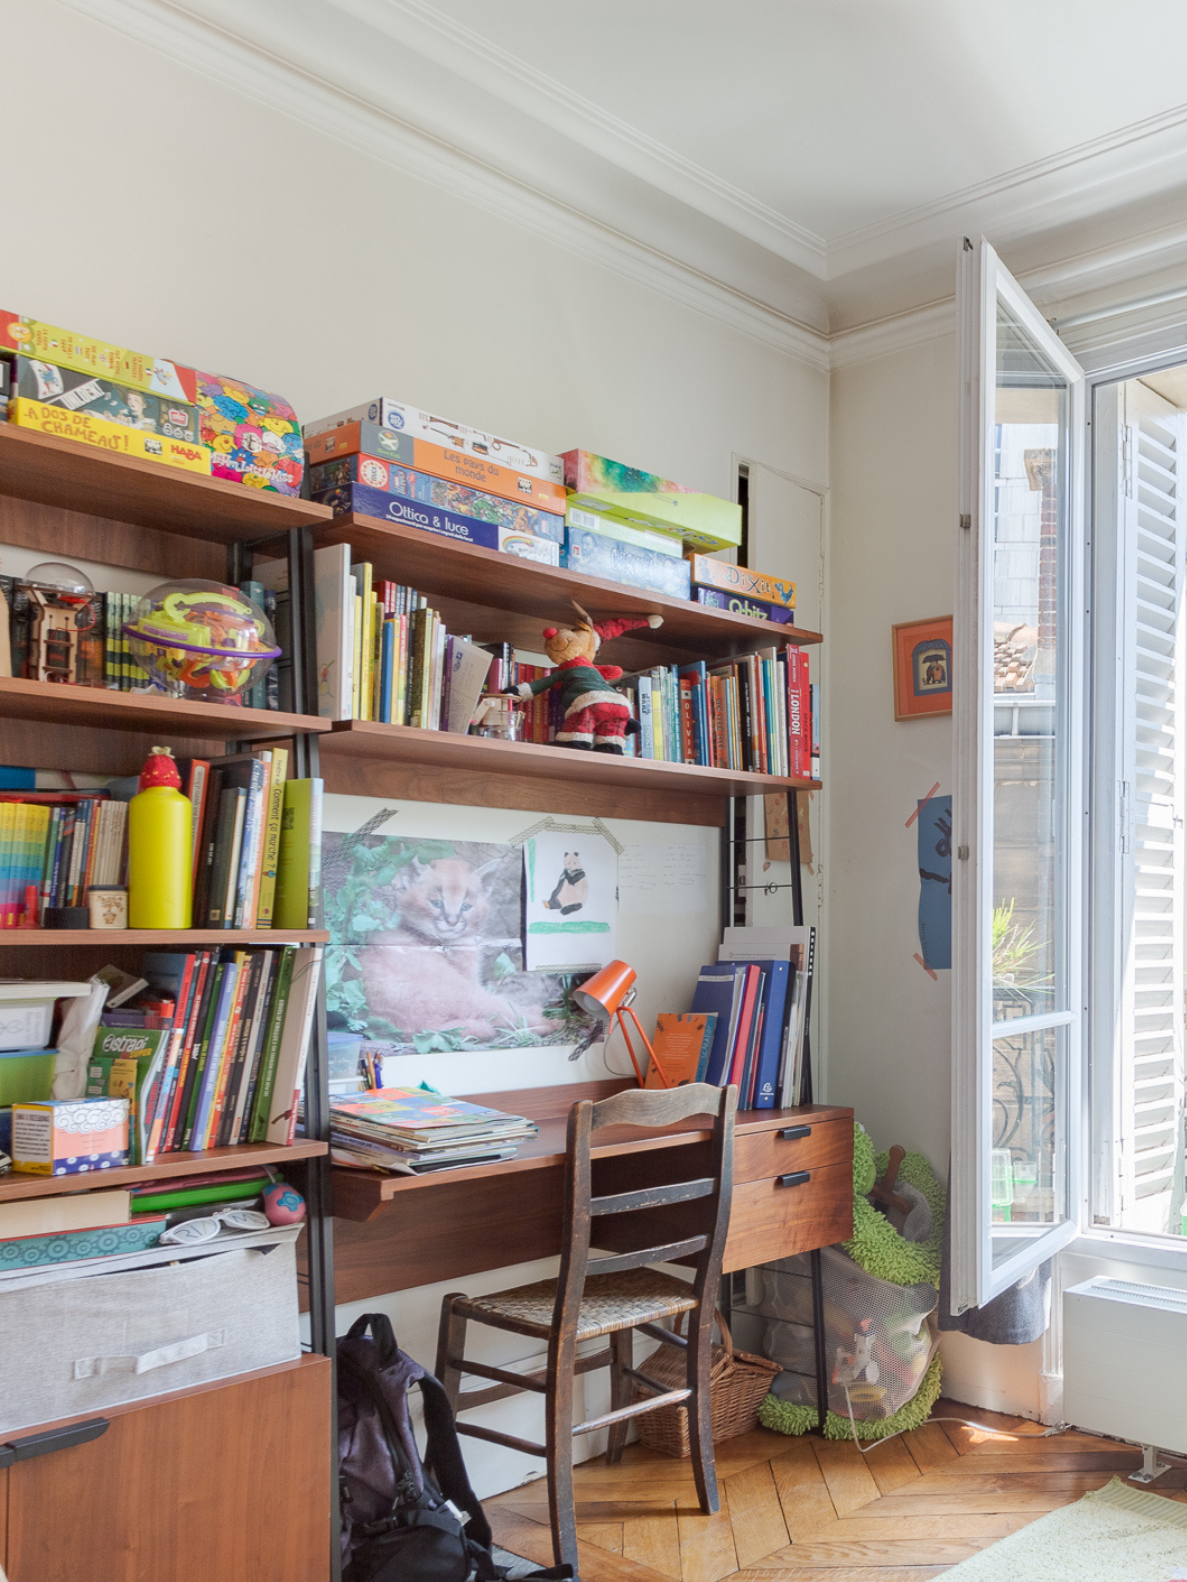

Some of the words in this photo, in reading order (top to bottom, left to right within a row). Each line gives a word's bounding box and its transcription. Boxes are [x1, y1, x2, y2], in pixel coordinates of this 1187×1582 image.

[25, 407, 38, 420] A
[42, 407, 68, 422] DOS
[72, 414, 91, 428] DE
[171, 444, 202, 461] HABA
[444, 450, 460, 464] Les
[464, 458, 484, 472] pays
[488, 463, 498, 476] du
[456, 465, 486, 482] monde
[388, 501, 428, 524] Ottica
[432, 515, 440, 527] &
[445, 519, 469, 536] luce
[790, 694, 800, 735] LONDON
[684, 702, 694, 754] OLIVIA
[270, 788, 281, 819] Comment
[268, 822, 276, 831] ça
[266, 833, 277, 860] marche
